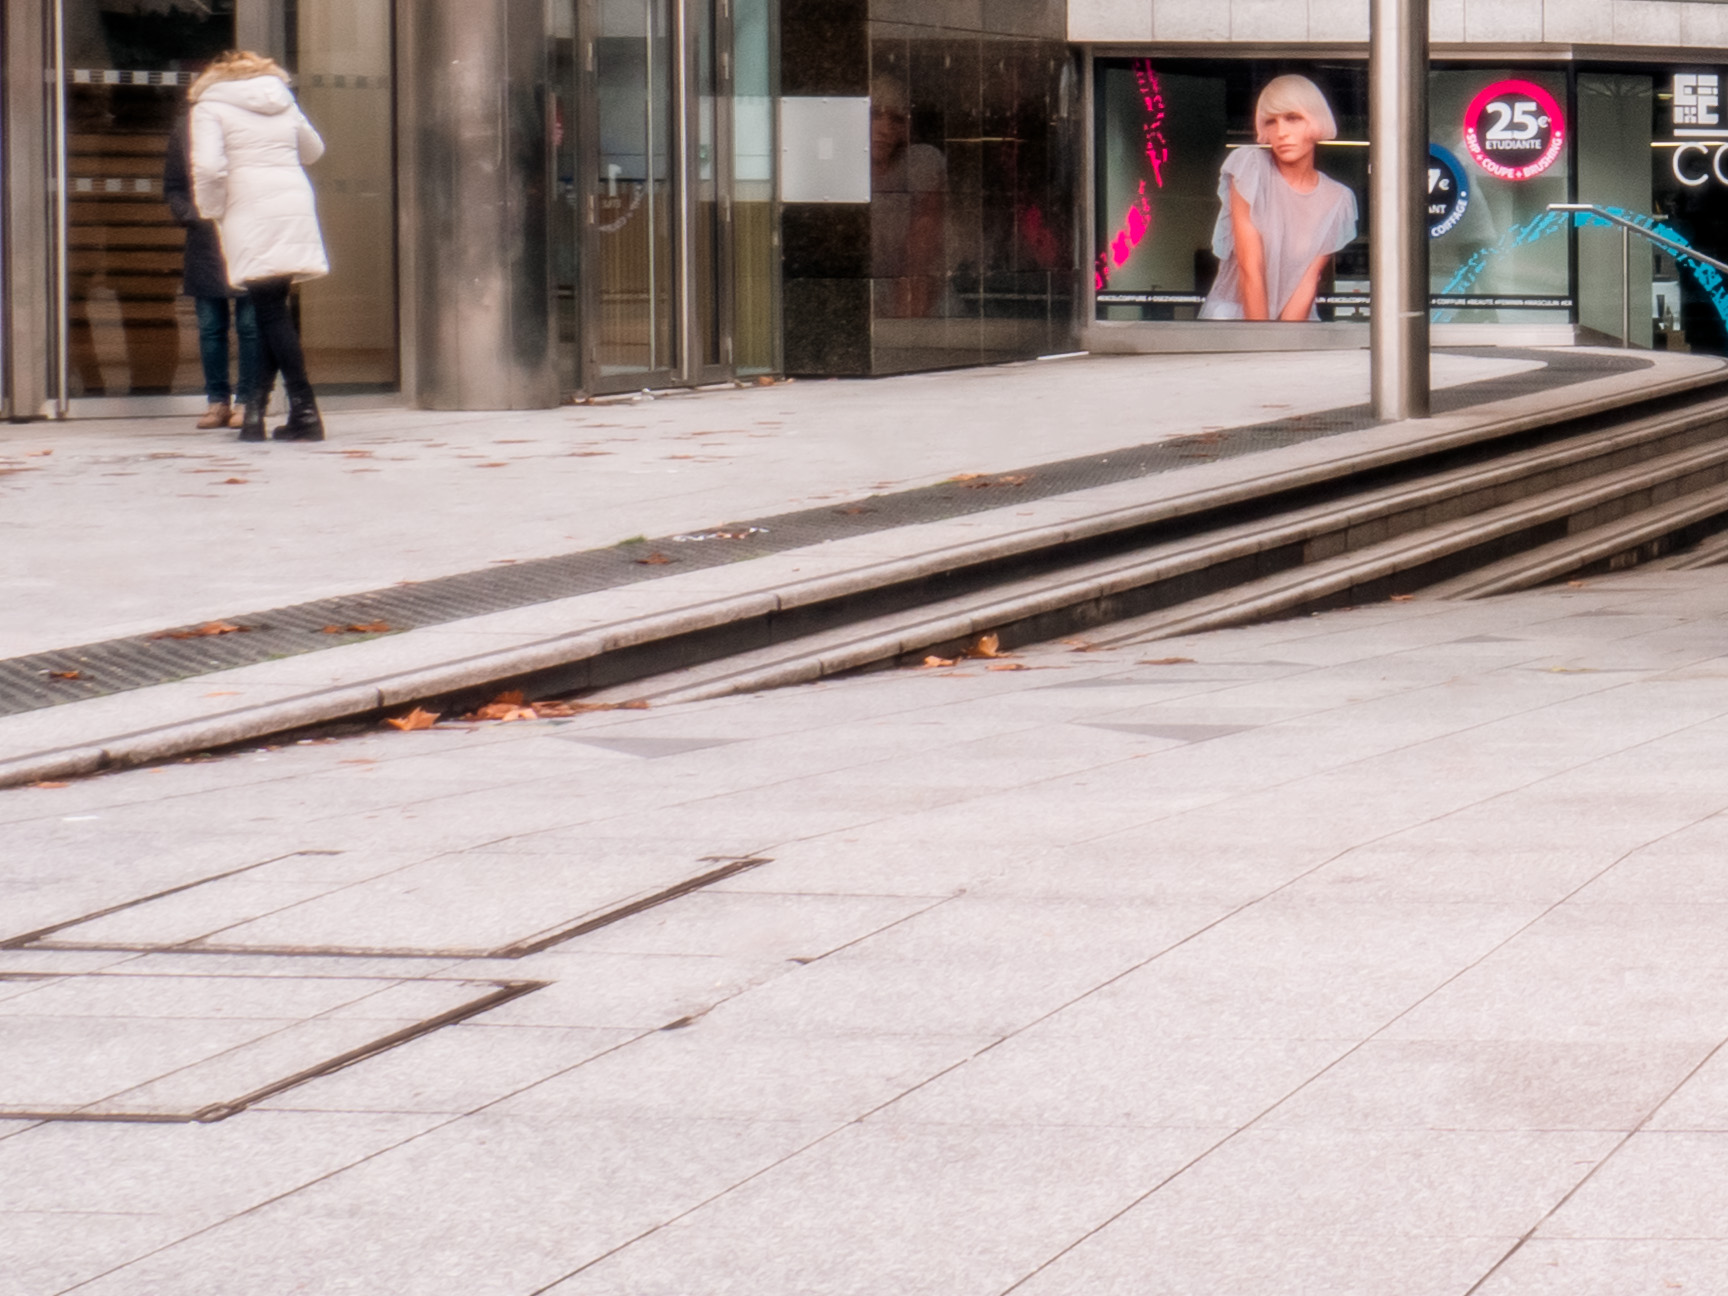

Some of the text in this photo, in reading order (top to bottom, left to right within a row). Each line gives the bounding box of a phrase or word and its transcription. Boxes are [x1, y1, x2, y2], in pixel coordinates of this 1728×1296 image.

[1482, 158, 1515, 179] COUPE
[1524, 135, 1563, 178] BRUSHING
[1485, 139, 1542, 150] ETUDIANTE
[1430, 198, 1469, 237] COIFFAGE
